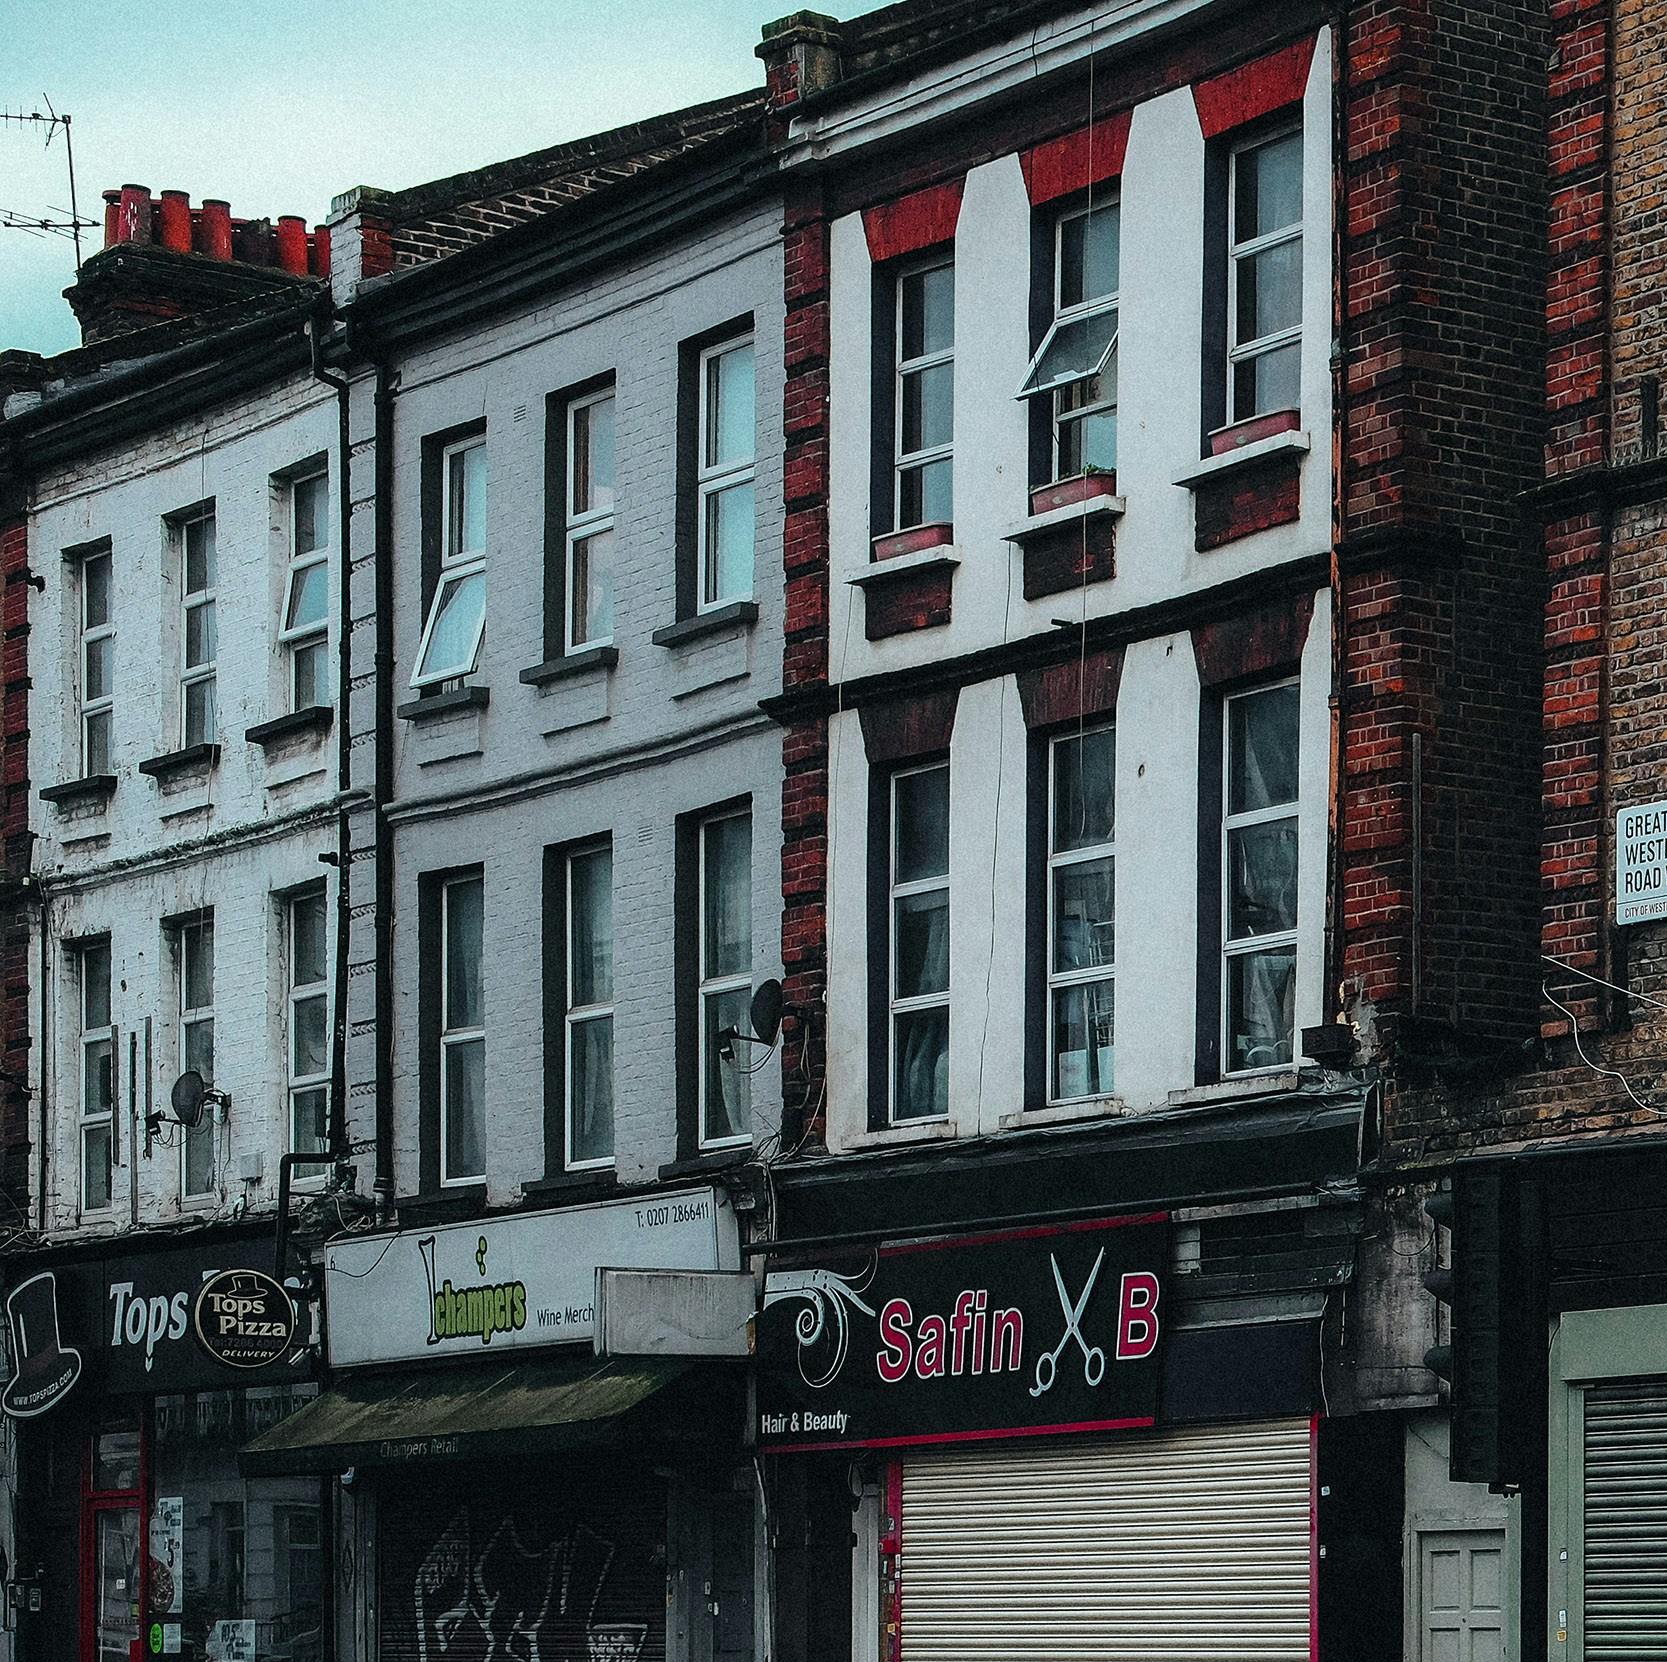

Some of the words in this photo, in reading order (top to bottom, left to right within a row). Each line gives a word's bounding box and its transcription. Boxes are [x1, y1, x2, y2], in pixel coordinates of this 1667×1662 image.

[1626, 867, 1661, 893] ROAD
[1625, 907, 1638, 918] CITY
[1640, 904, 1649, 915] OF
[646, 1208, 669, 1226] 0207
[673, 1202, 709, 1223] 2866411
[208, 1293, 266, 1320] Tops
[434, 1279, 526, 1345] champers
[537, 1309, 561, 1327] Wine
[565, 1303, 595, 1325] Merch
[109, 1281, 189, 1372] Tops
[219, 1316, 287, 1337] Pizza
[876, 1289, 1023, 1383] Safin
[1116, 1272, 1161, 1361] B
[222, 1350, 276, 1358] DELIVERY
[13, 1369, 73, 1405] WWW.TOPSPIZZA.COM
[762, 1413, 789, 1434] Hair
[790, 1412, 799, 1432] &
[804, 1410, 848, 1434] Beauty
[380, 1441, 427, 1459] Champers
[431, 1436, 459, 1454] Retail
